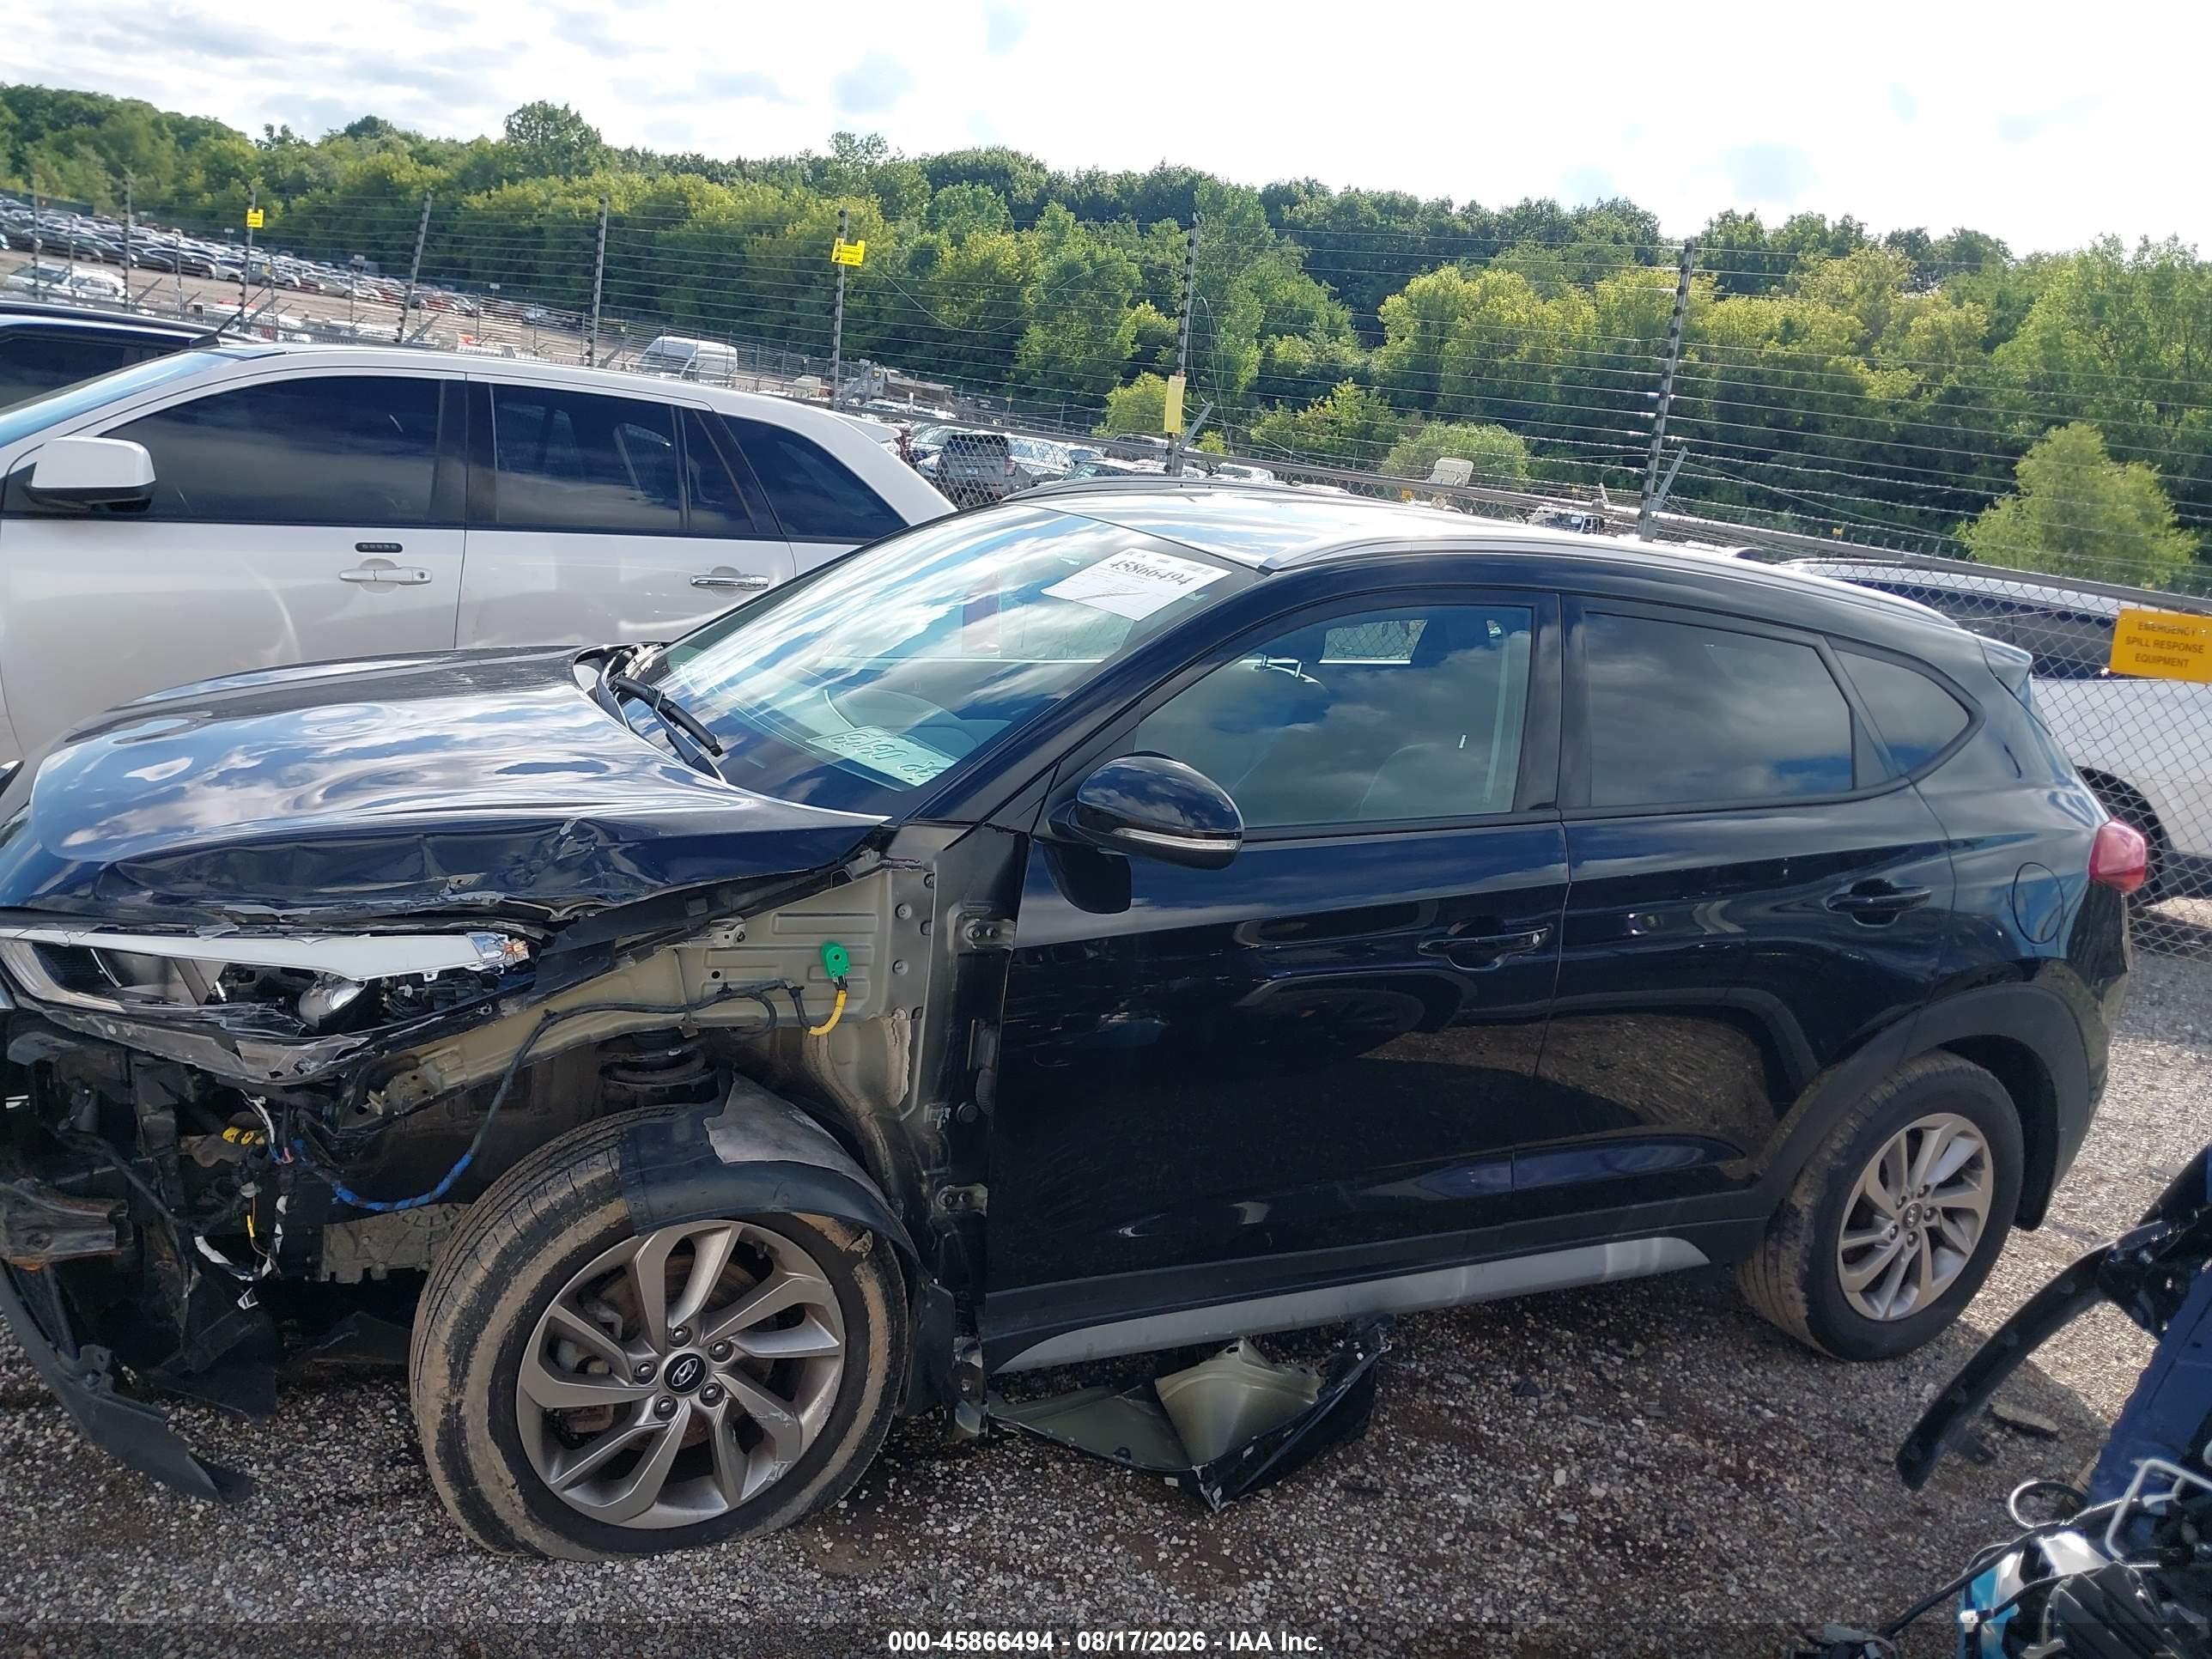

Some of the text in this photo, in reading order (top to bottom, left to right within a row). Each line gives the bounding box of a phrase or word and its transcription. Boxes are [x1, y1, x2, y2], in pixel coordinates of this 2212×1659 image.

[1109, 559, 1196, 586] 45866494
[2137, 622, 2197, 637] EMERGENCY
[2125, 635, 2205, 653] SPILL RESPONSE
[2135, 653, 2190, 668] EQUIPMENT
